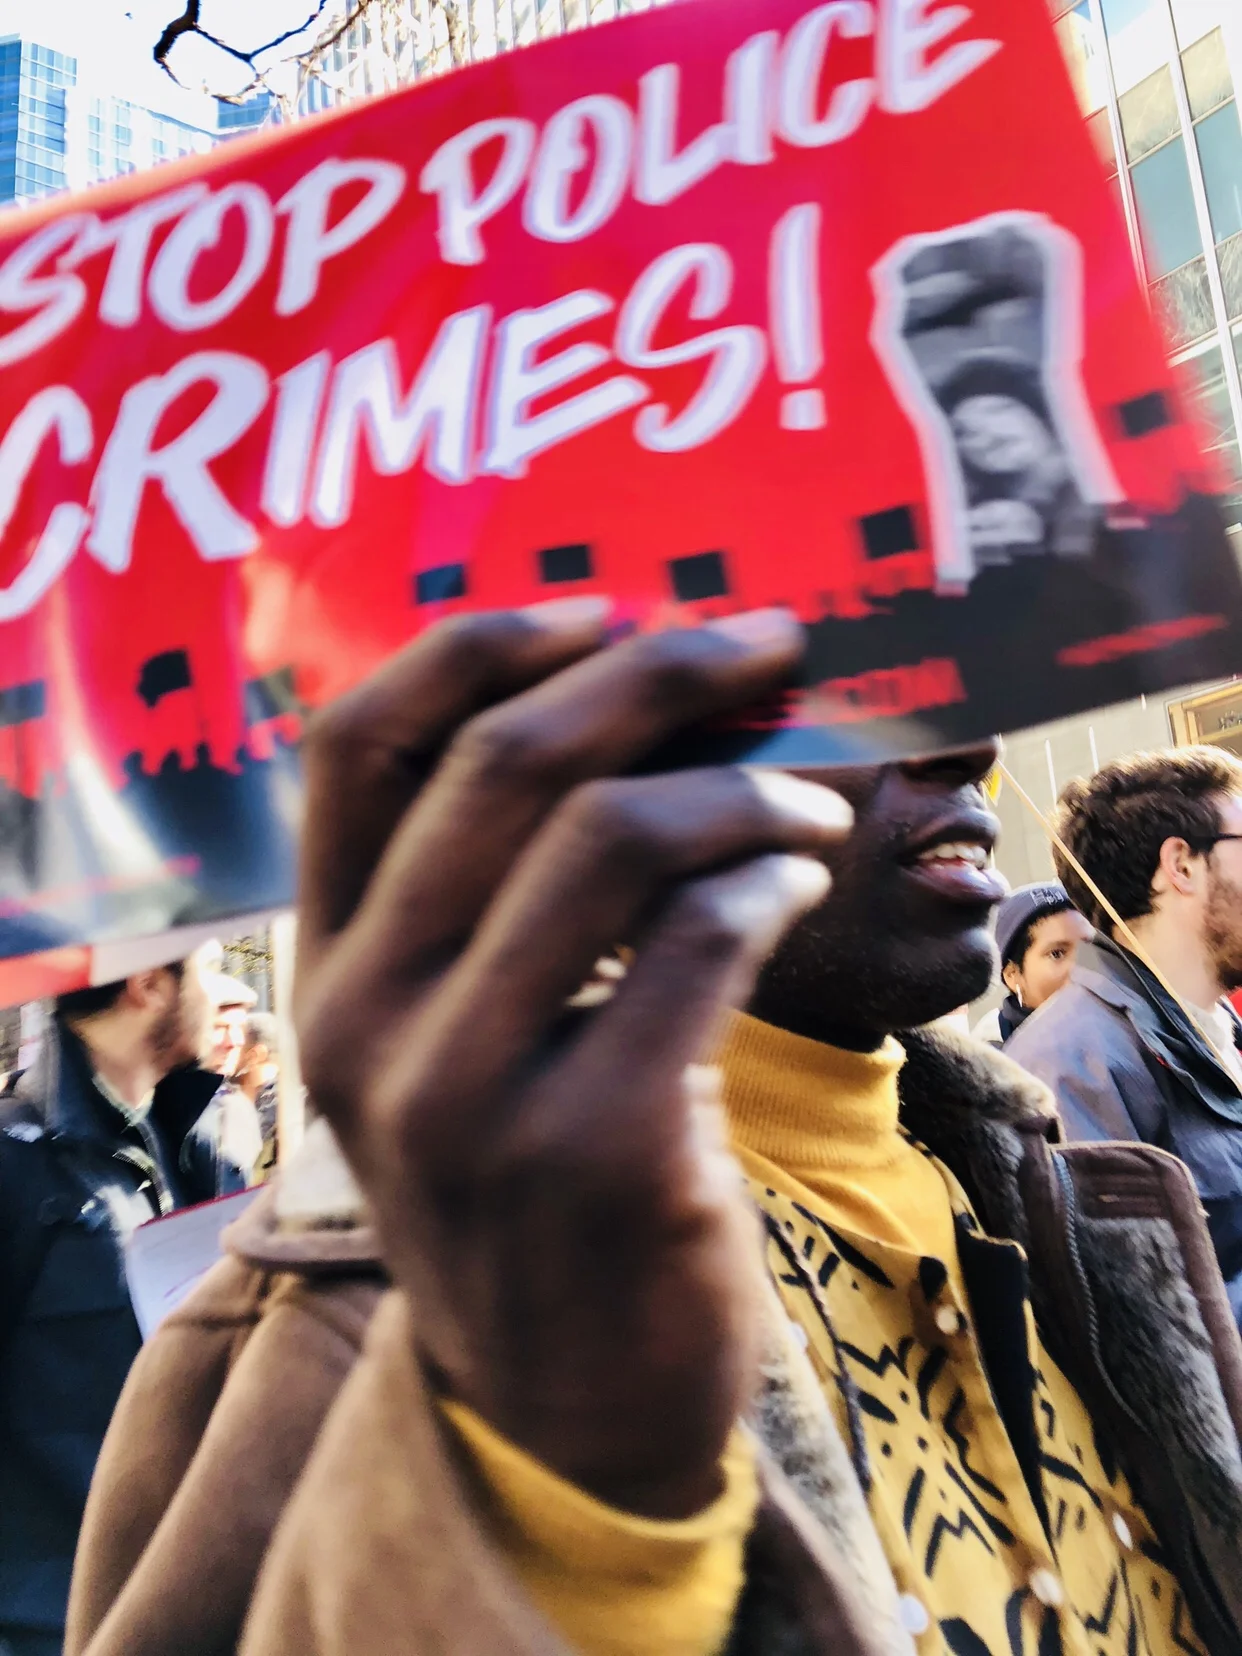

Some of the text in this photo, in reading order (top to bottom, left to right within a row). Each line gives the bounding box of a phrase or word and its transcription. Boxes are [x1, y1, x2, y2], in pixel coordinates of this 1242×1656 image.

[0, 0, 1001, 368] STOP POLICE
[0, 203, 826, 620] CRIMES!
